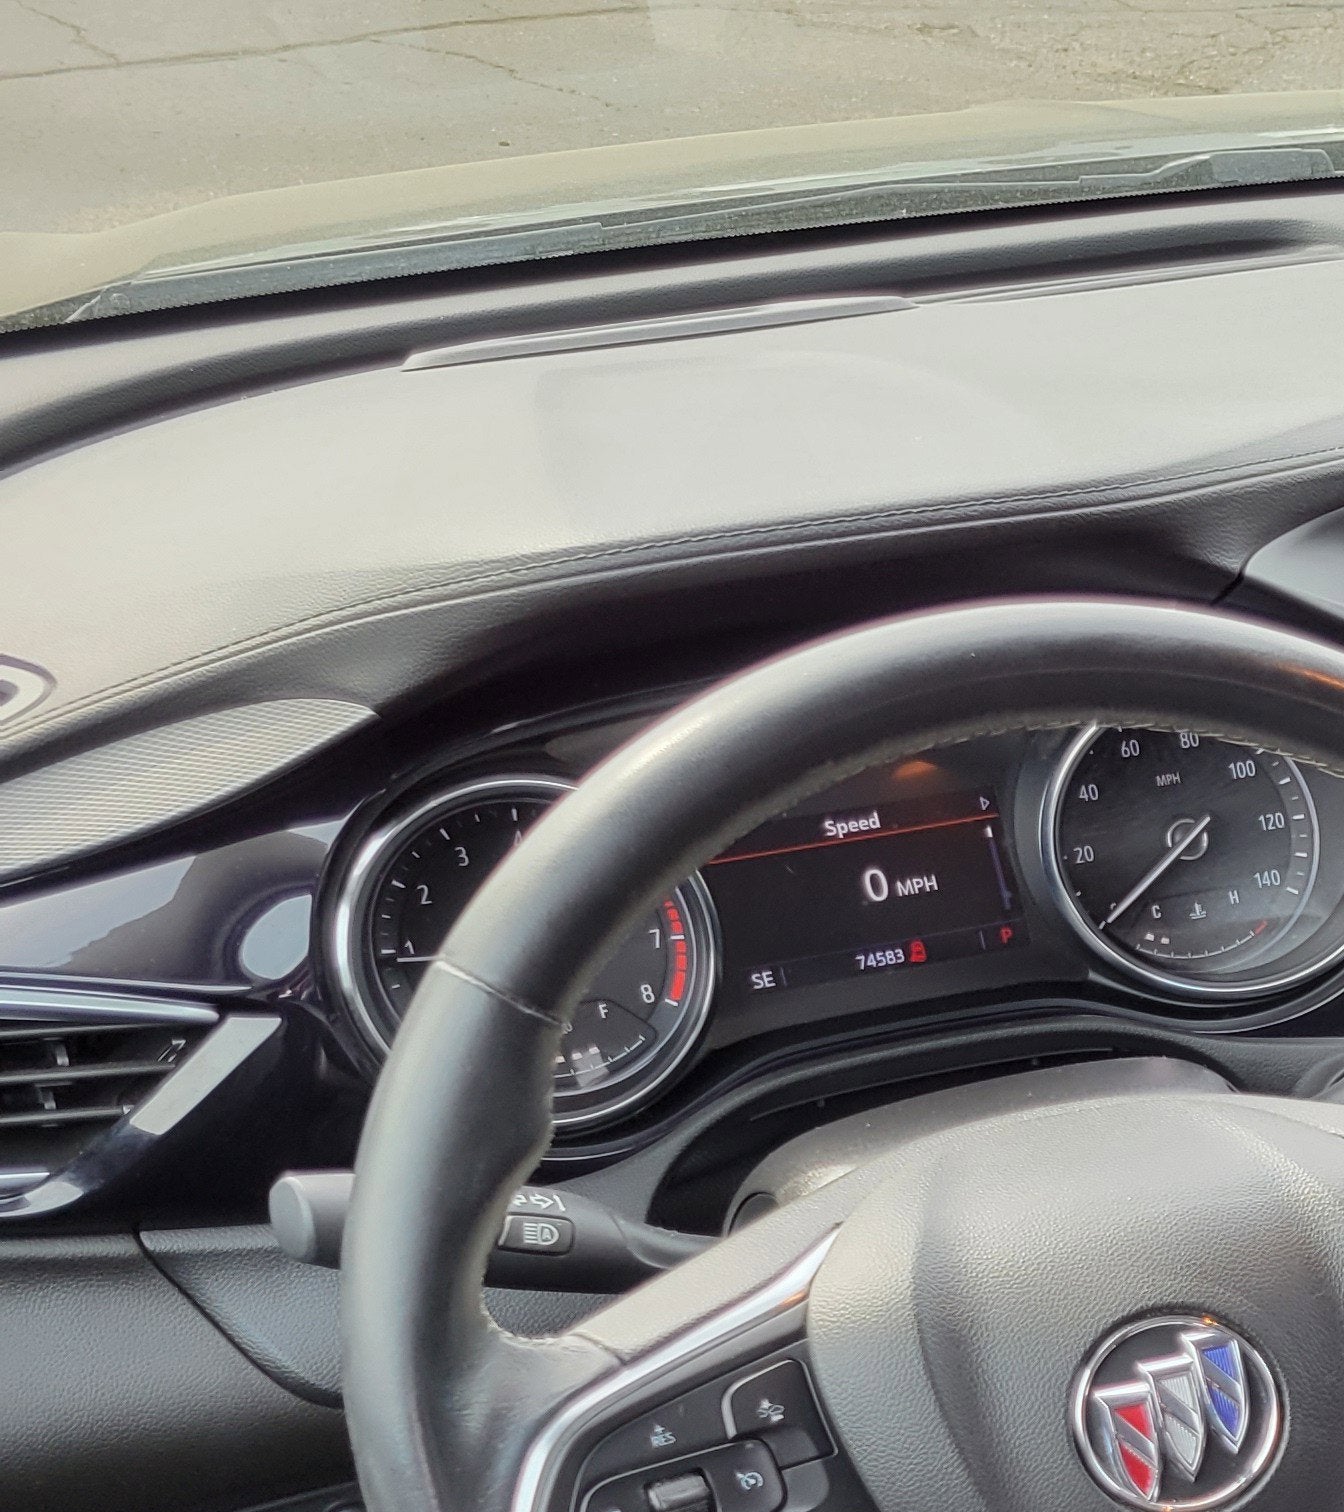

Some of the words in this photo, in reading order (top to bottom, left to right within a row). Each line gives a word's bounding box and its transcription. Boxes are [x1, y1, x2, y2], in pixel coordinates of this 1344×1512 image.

[1120, 739, 1140, 758] 60
[1179, 732, 1200, 749] 80
[1228, 760, 1256, 779] 100
[1155, 772, 1182, 788] MPH
[1078, 784, 1099, 802] 40
[824, 810, 881, 838] Speed
[1258, 812, 1285, 832] 120
[454, 846, 470, 867] 3
[1073, 845, 1094, 864] 20
[863, 866, 890, 902] 0
[895, 874, 939, 897] MPH
[1253, 869, 1281, 889] 140
[416, 884, 432, 905] 2
[1228, 889, 1240, 905] H
[1151, 904, 1162, 919] C
[648, 928, 661, 949] 7
[1000, 926, 1013, 944] P
[855, 948, 905, 971] 74583
[751, 970, 776, 990] SE
[640, 984, 655, 1004] 8
[598, 1003, 609, 1019] F
